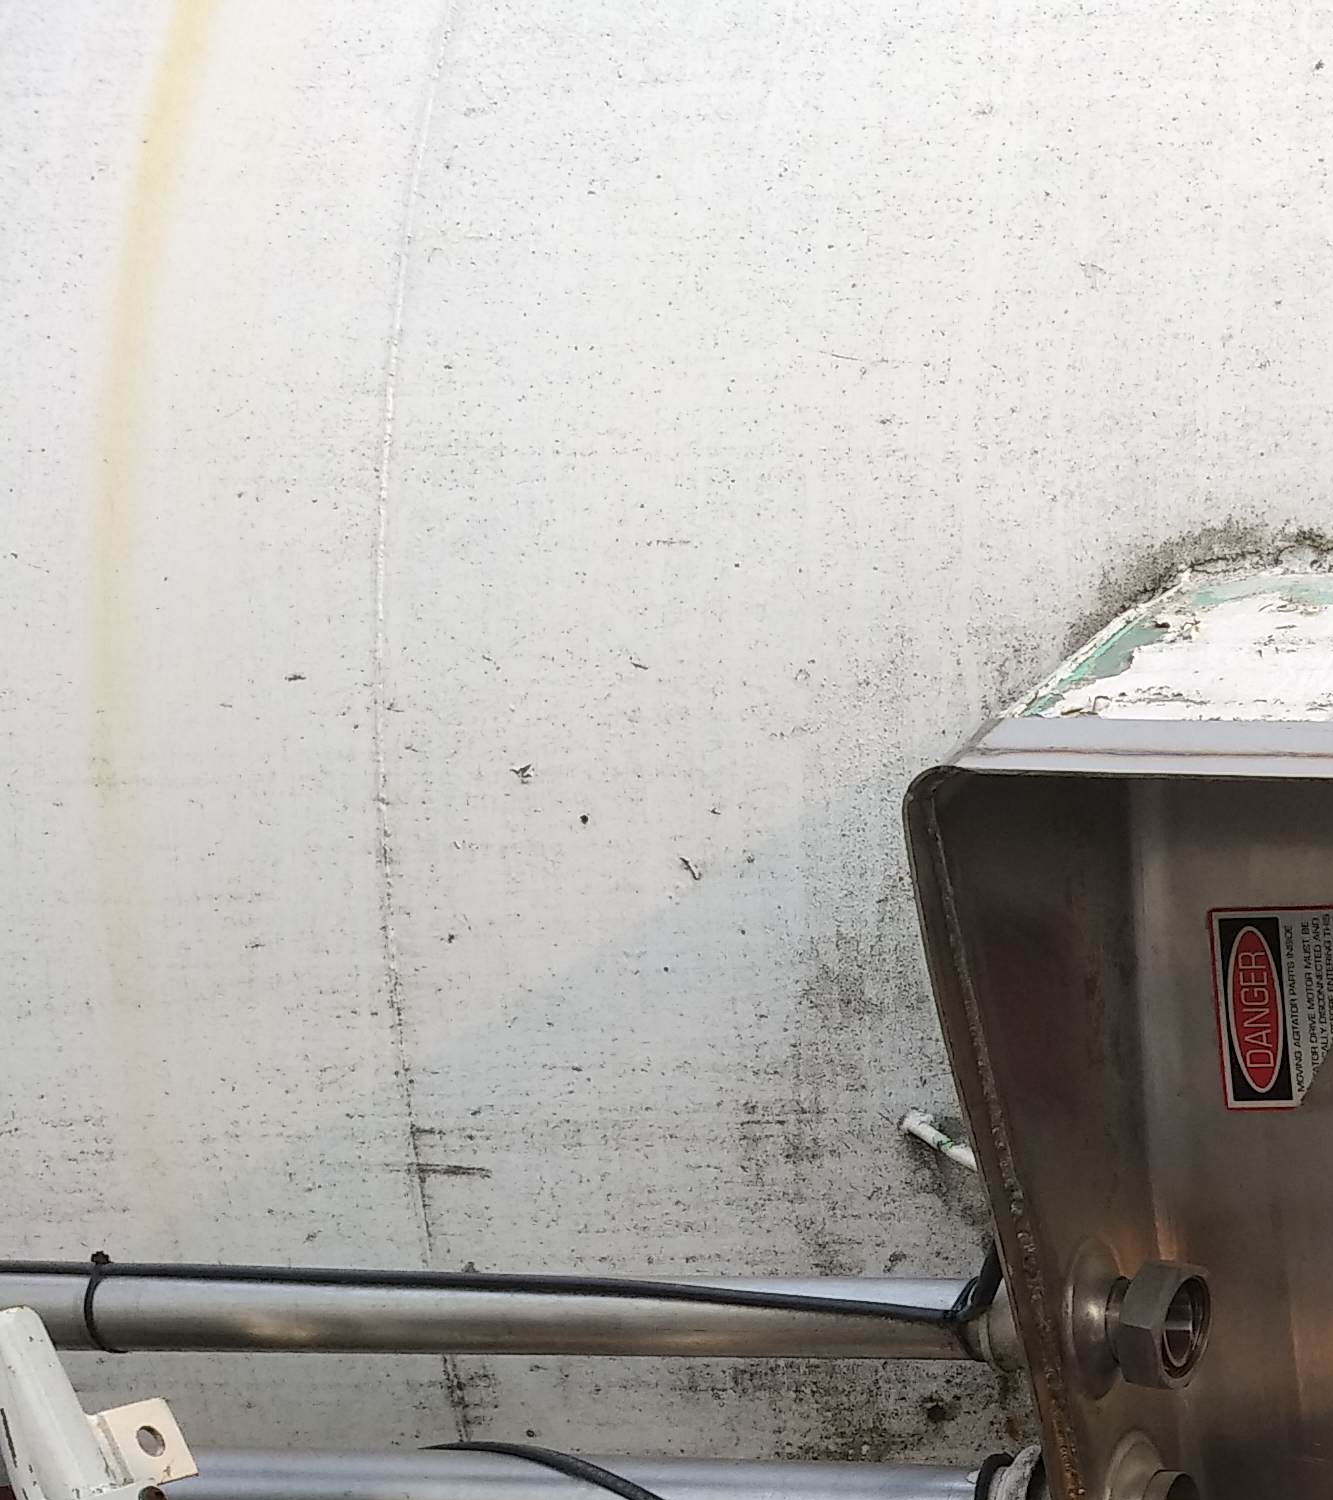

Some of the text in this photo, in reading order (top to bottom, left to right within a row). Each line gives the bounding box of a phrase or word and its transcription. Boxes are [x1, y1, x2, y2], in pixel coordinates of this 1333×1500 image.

[1312, 916, 1321, 941] AND
[1314, 943, 1327, 1024] DISCONNECTED
[1238, 951, 1274, 1067] DANGER
[1284, 924, 1304, 1092] MOVING AGITATOR PARTS INSIDE
[1301, 920, 1321, 1077] ATOR DRIVE MOTOR MUST BE
